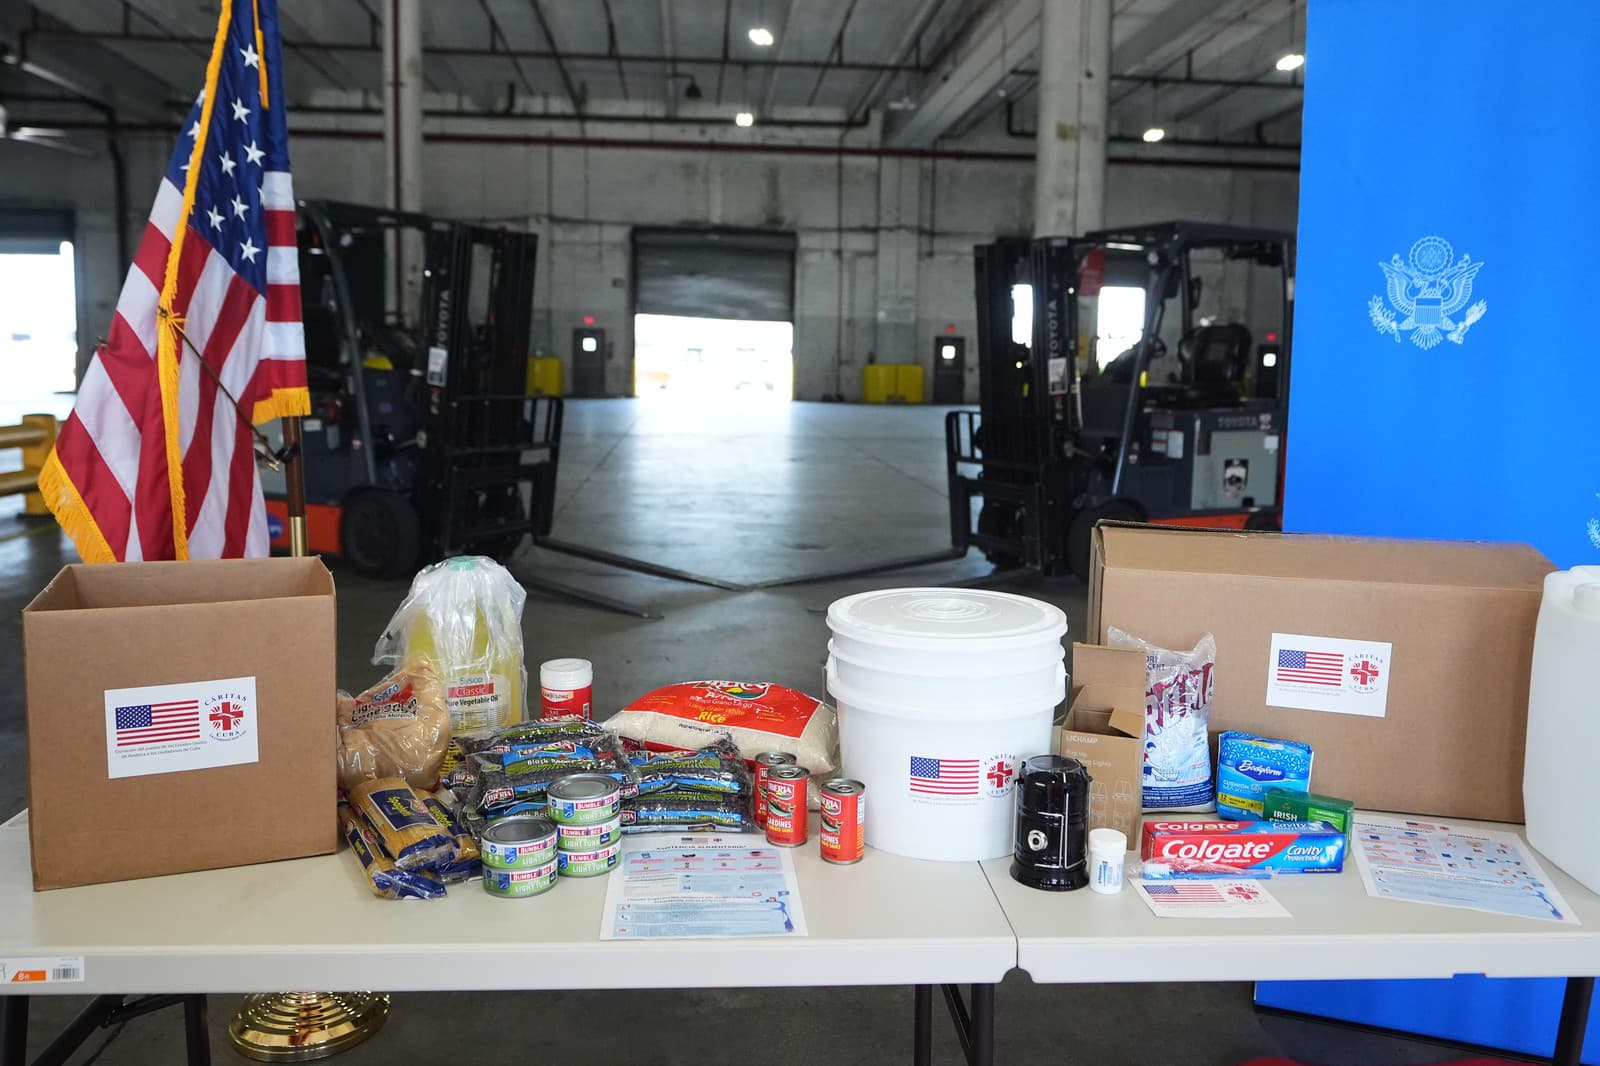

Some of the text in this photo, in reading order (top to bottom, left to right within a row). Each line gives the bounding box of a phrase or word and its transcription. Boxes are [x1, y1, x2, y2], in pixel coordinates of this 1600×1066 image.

[1217, 416, 1258, 429] TOYOTA
[205, 692, 247, 706] CARITAS
[459, 697, 490, 707] Vegetable
[490, 695, 498, 703] Oil
[698, 711, 726, 723] Rice
[1238, 759, 1282, 777] Bodyform
[577, 800, 601, 810] BUMBLE
[1274, 810, 1298, 822] IRISH
[563, 828, 586, 837] BUMBLE
[1154, 821, 1241, 832] Colgate
[520, 844, 544, 854] BUMBLE
[1161, 838, 1270, 864] Colgate
[1287, 844, 1323, 857] Cavity
[570, 852, 594, 861] BUMBLE
[1282, 853, 1321, 863] Protection
[513, 870, 538, 880] BUMBLE
